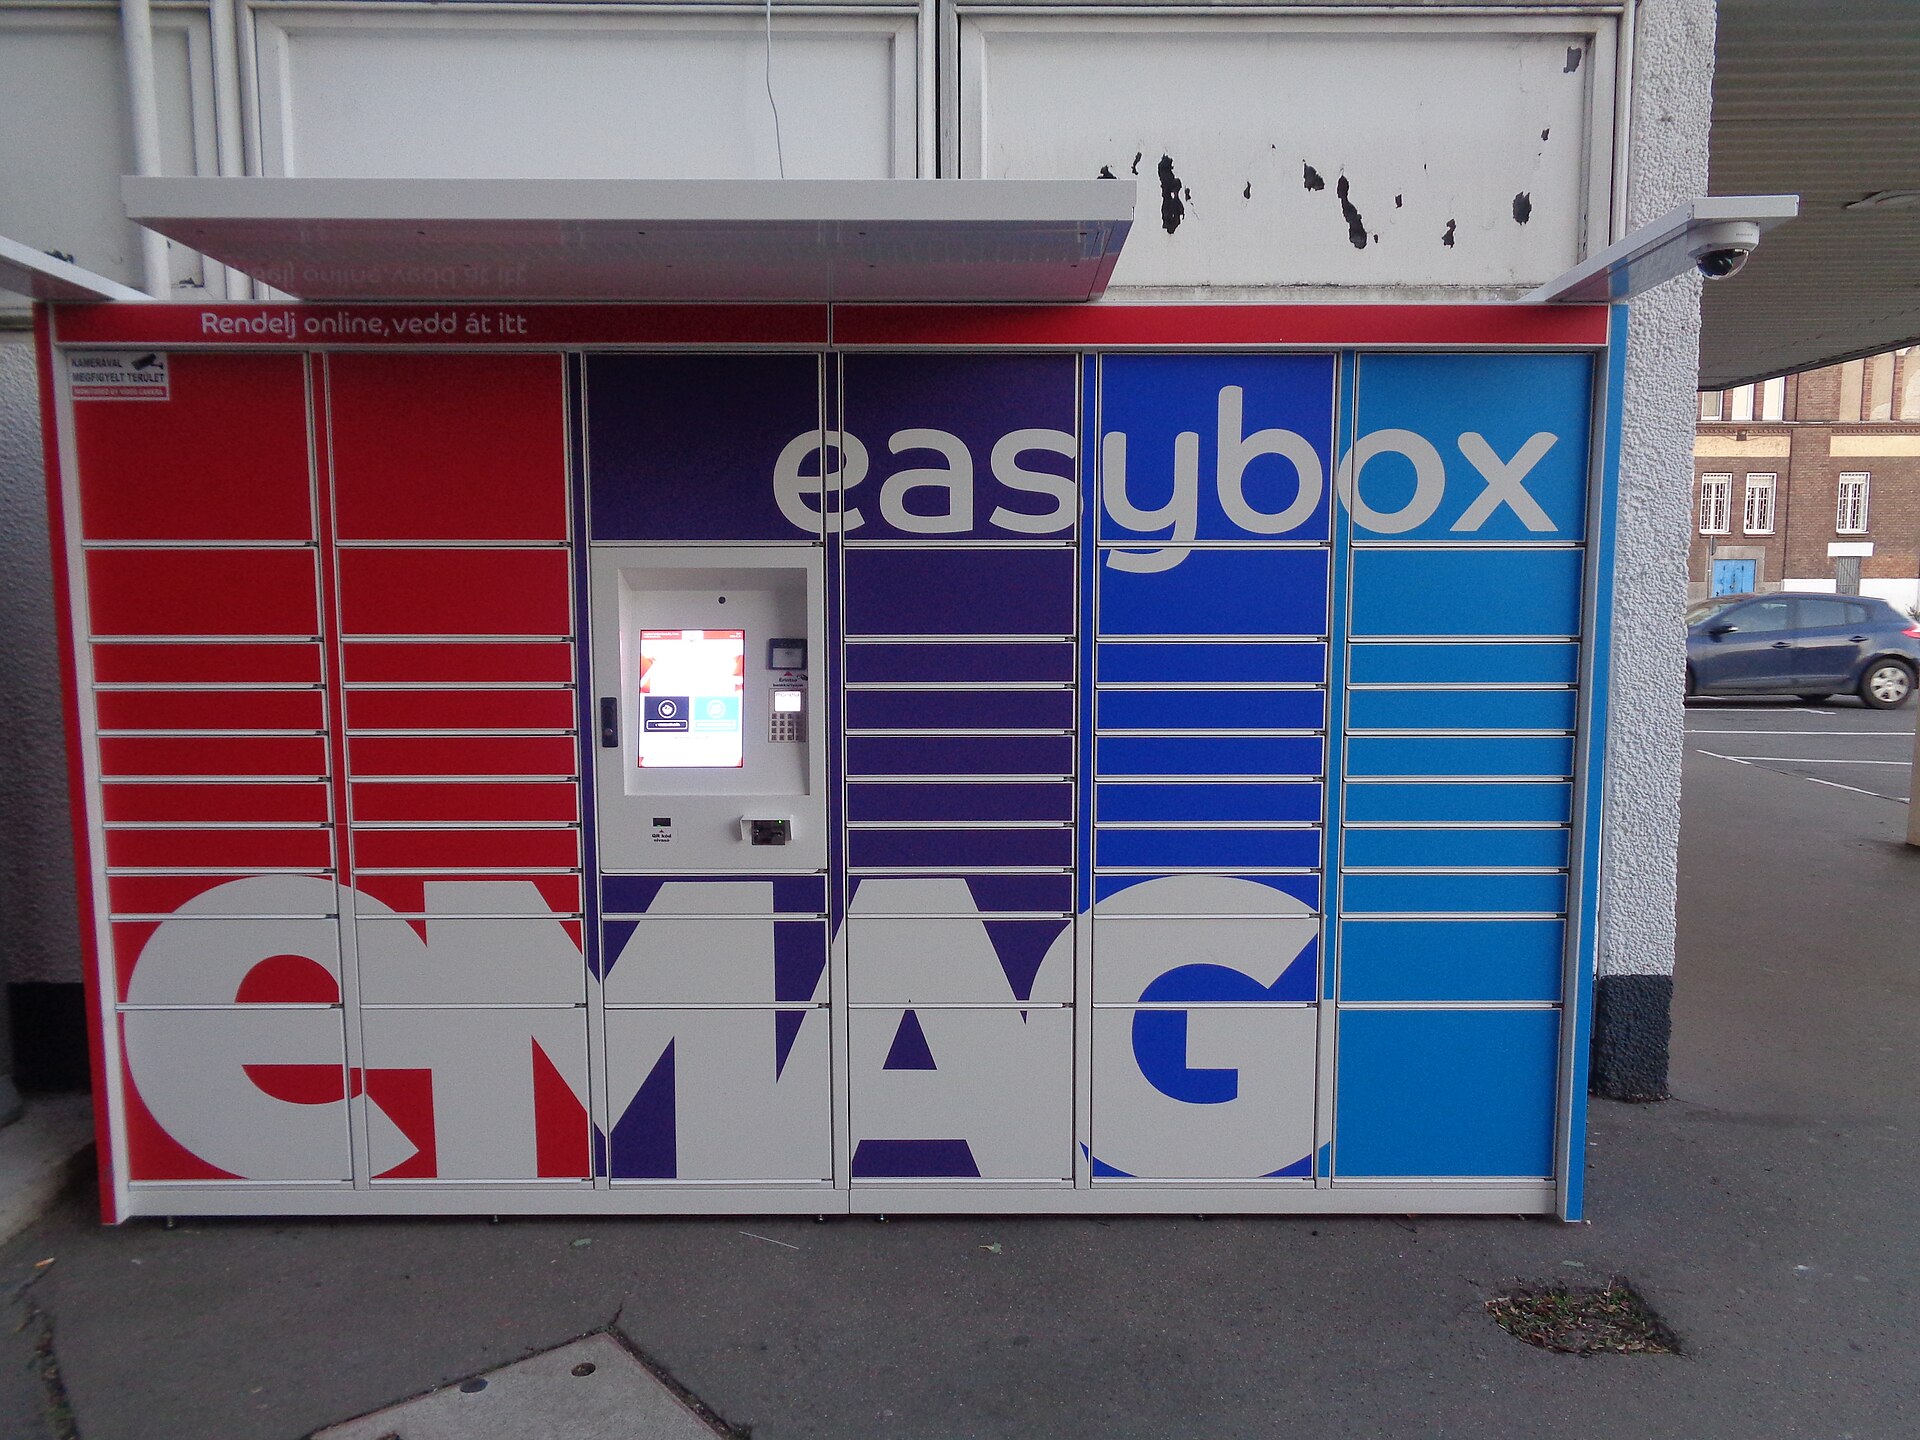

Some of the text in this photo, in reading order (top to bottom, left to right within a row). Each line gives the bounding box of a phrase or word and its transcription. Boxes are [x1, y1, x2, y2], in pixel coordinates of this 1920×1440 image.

[201, 312, 527, 339] Rendelj online, vedd át itt
[71, 357, 122, 368] KAMERAVAL
[72, 372, 164, 382] MEGFIGYELT TERÜLET
[773, 385, 1560, 573] easybox
